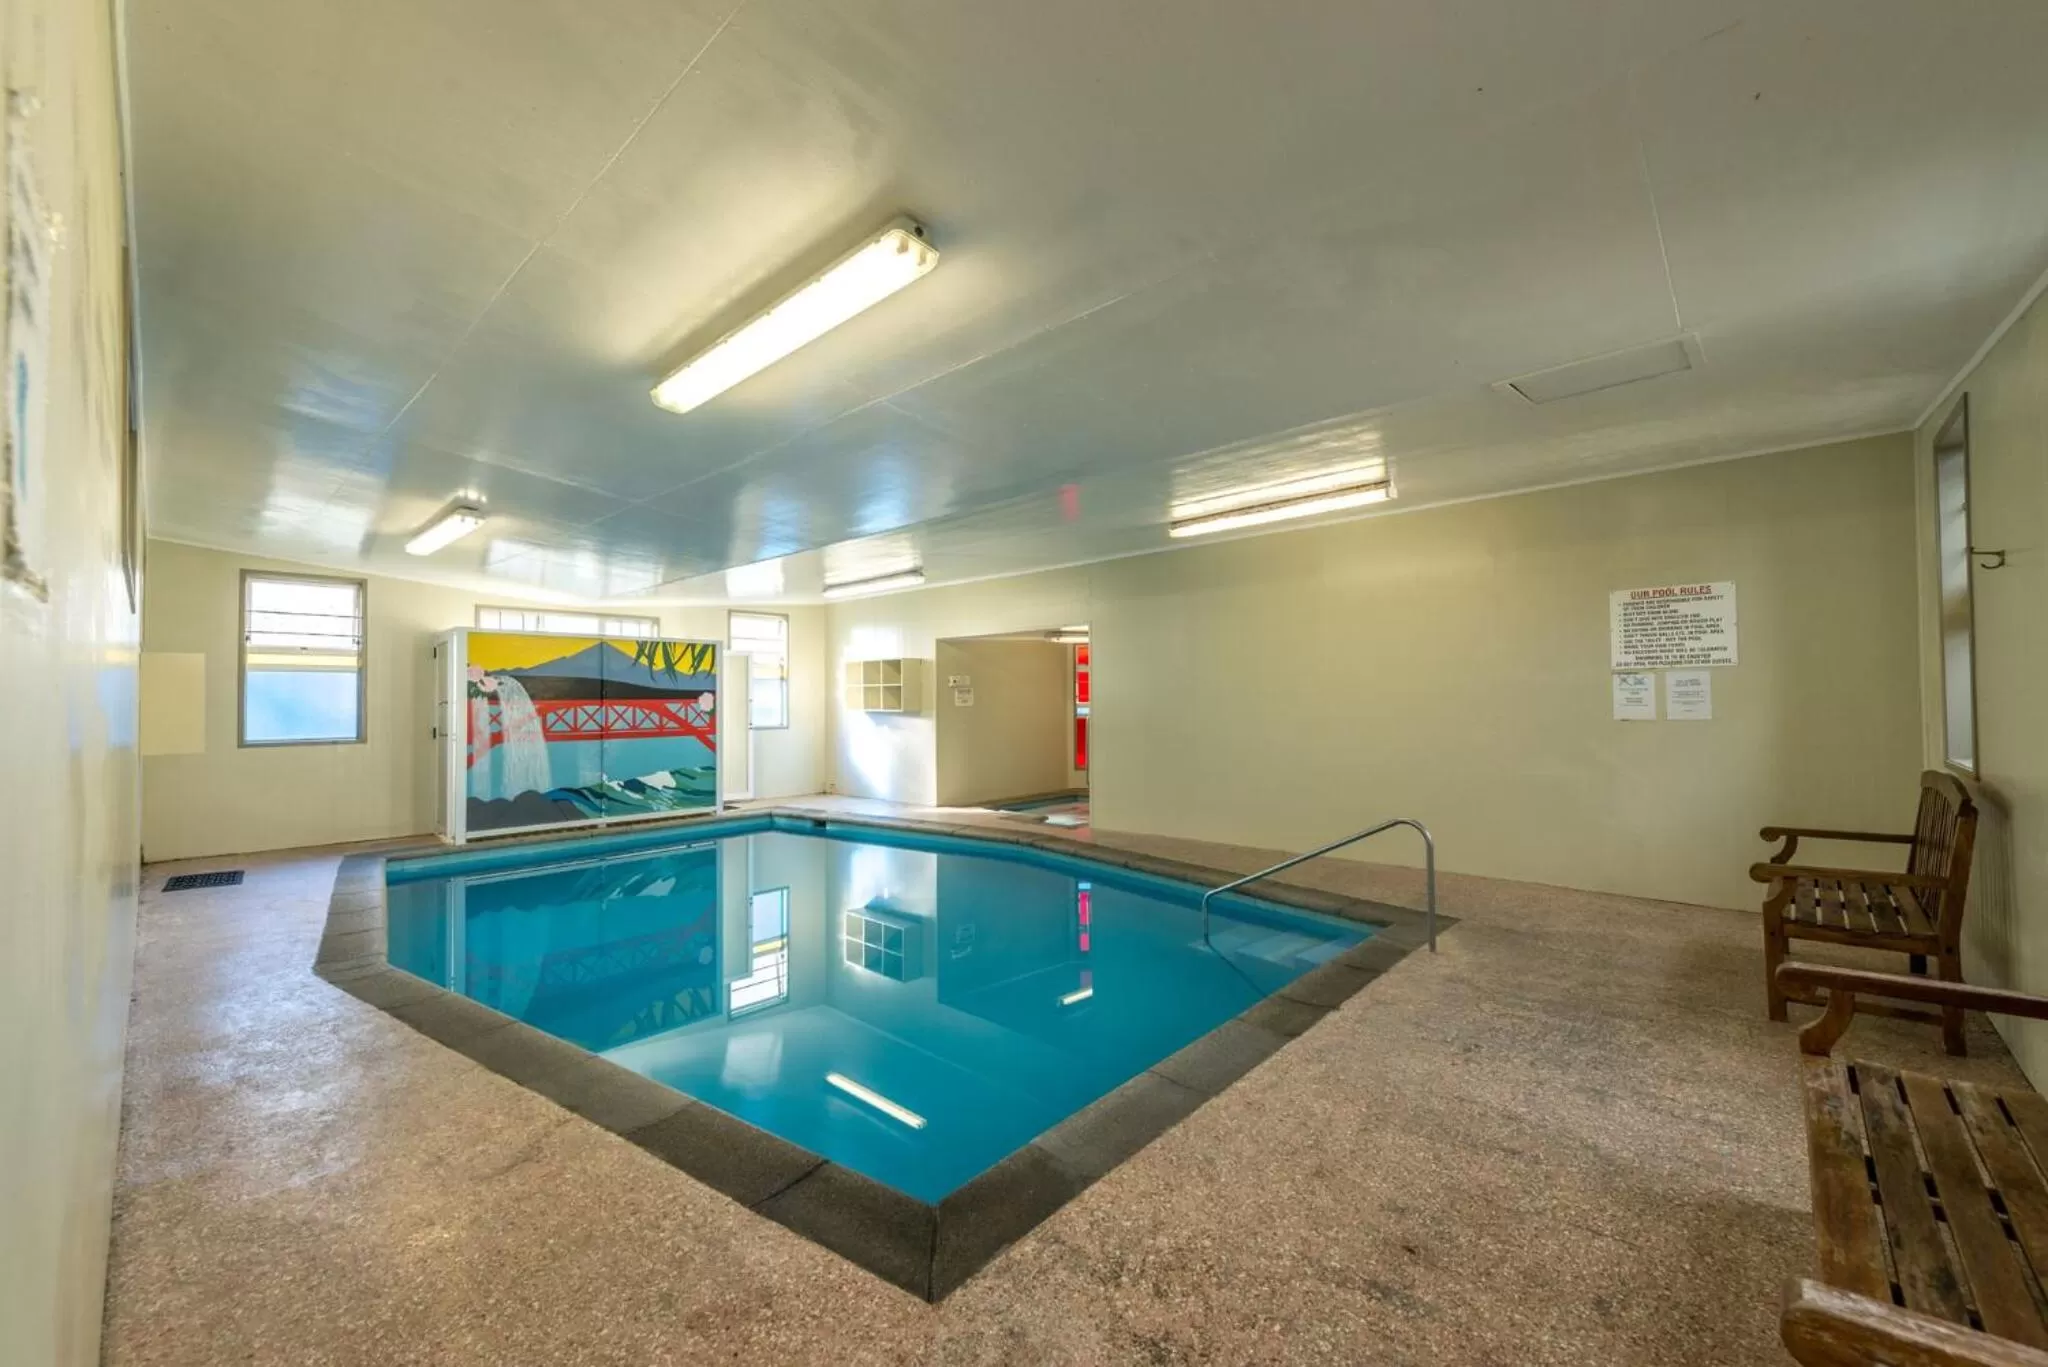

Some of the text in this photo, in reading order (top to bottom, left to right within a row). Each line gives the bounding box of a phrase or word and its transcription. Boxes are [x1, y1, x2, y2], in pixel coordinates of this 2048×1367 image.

[1631, 586, 1712, 599] OUR POOL RULES
